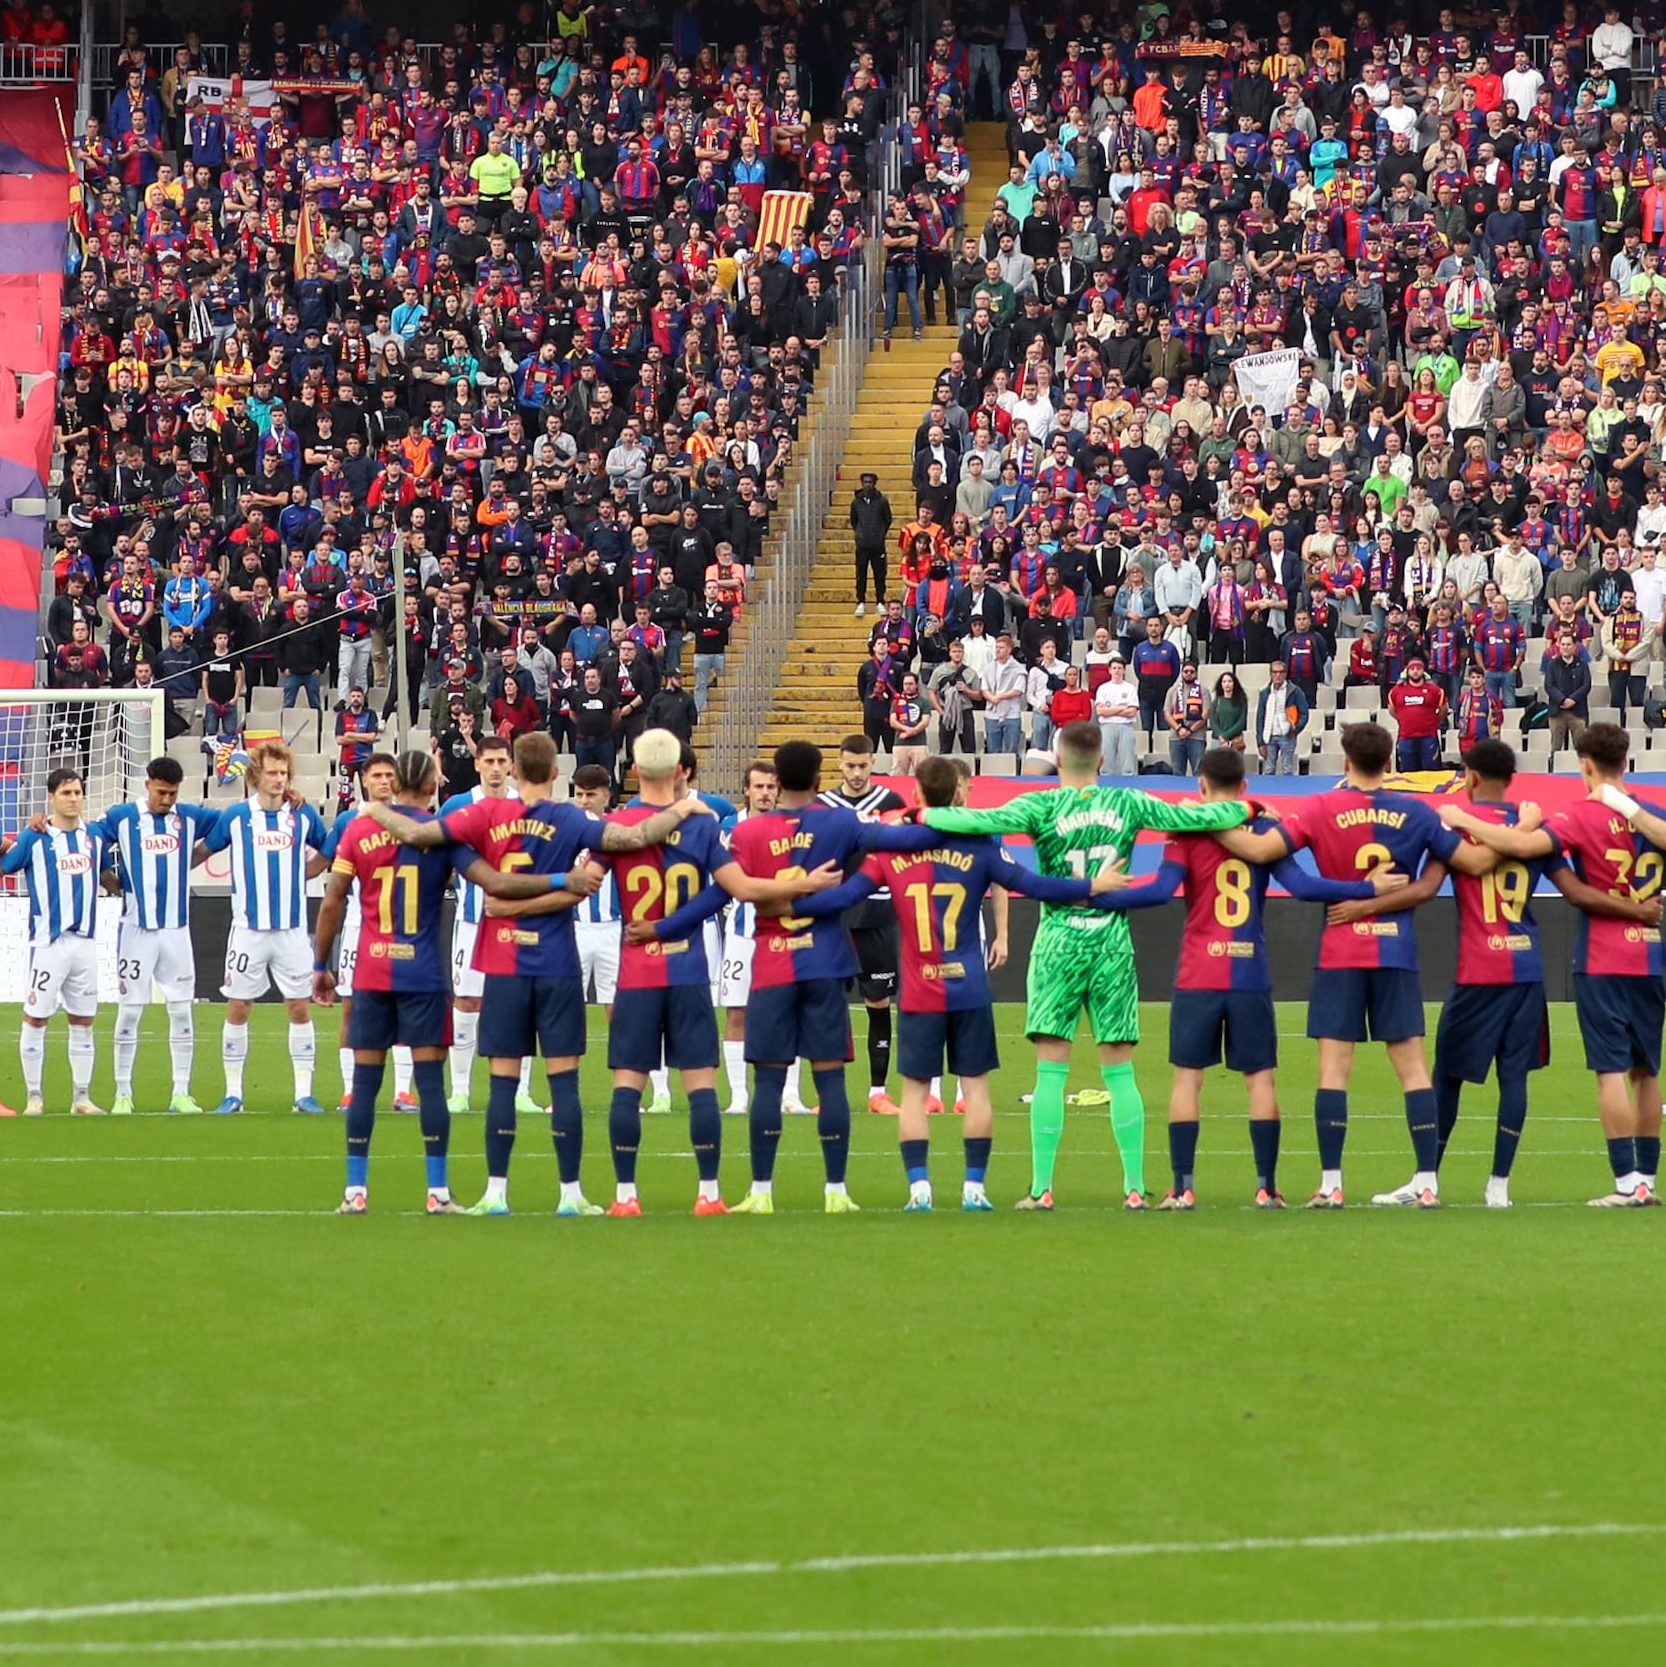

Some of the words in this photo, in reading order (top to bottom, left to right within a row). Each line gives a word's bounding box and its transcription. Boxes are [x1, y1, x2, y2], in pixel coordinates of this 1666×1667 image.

[197, 86, 222, 97] RB
[1336, 808, 1407, 830] CUBARSÍ
[144, 836, 175, 851] DANI
[257, 833, 288, 848] DANI
[59, 856, 90, 870] DANI
[912, 849, 974, 872] CASADÓ
[1604, 849, 1665, 904] 32
[371, 864, 420, 934] 11
[627, 862, 703, 922] 20
[1214, 859, 1251, 928] 8
[1481, 861, 1529, 923] 19
[904, 883, 967, 953] 17
[119, 959, 141, 980] 23
[227, 949, 250, 973] 20
[454, 948, 465, 969] 4
[722, 958, 744, 981] 22
[32, 968, 51, 991] 12
